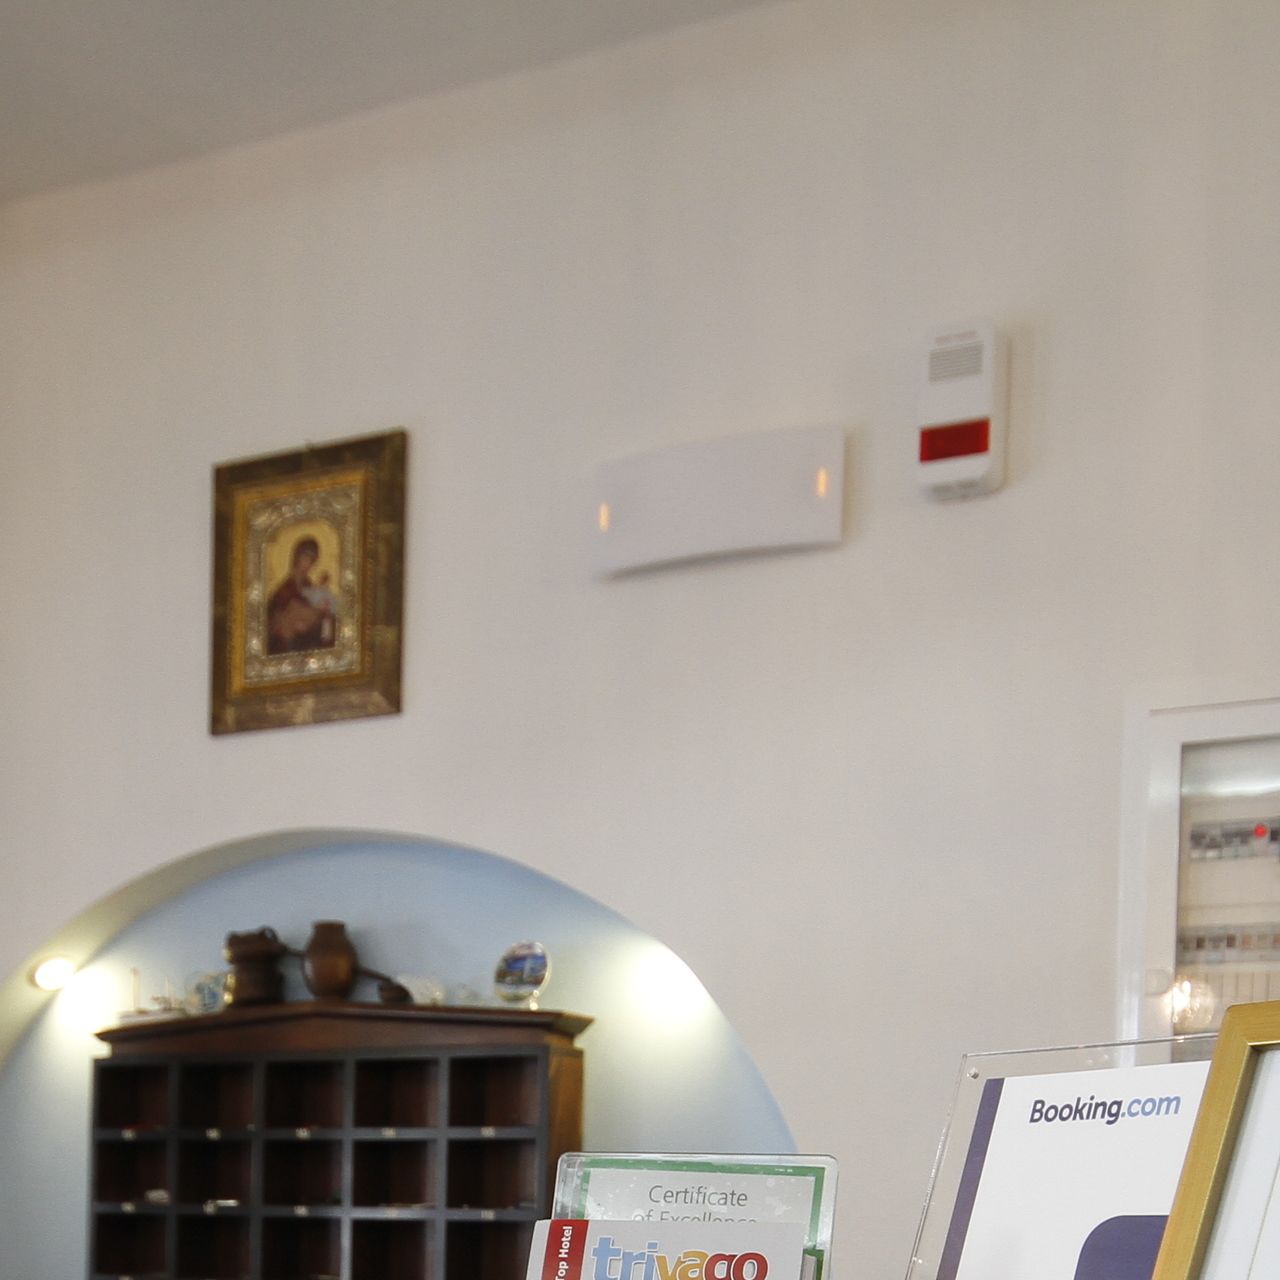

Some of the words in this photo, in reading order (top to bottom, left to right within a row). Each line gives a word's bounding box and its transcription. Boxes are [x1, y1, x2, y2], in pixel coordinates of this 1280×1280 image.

[1029, 1095, 1181, 1125] Booking.com
[648, 1185, 748, 1207] Certificate
[559, 1226, 573, 1258] Hotel
